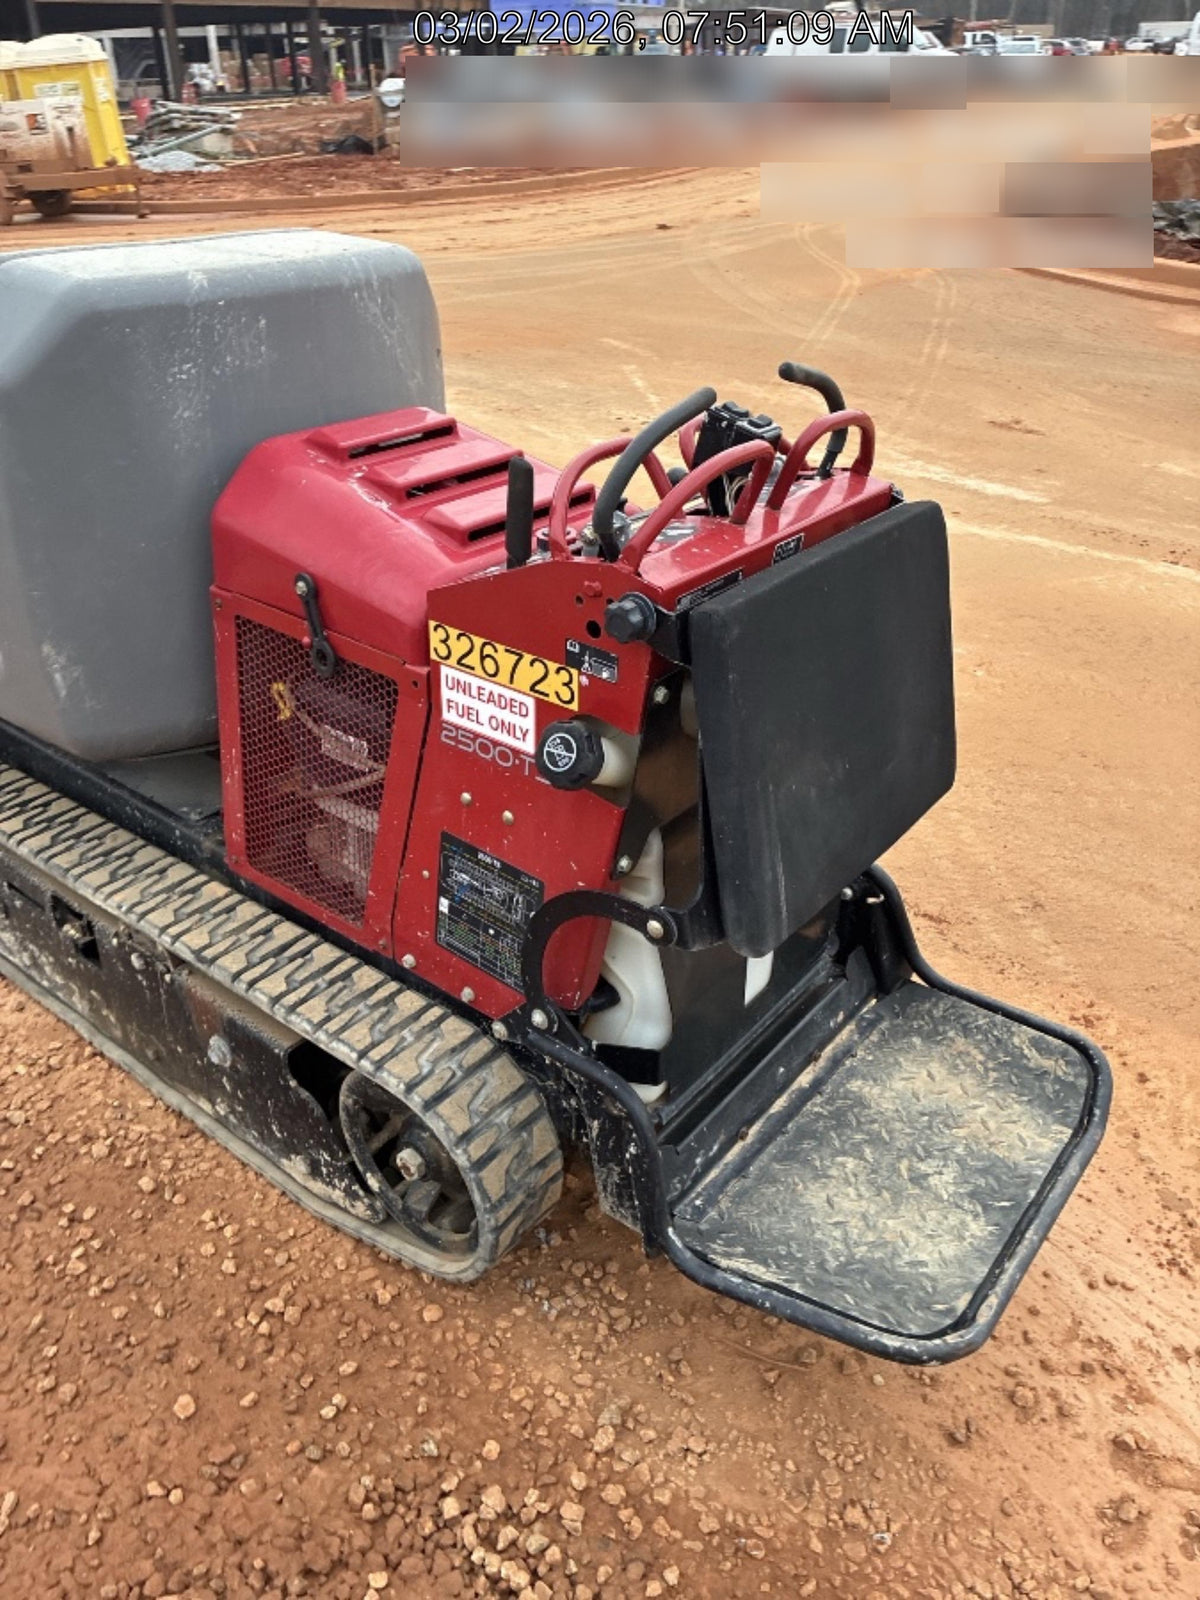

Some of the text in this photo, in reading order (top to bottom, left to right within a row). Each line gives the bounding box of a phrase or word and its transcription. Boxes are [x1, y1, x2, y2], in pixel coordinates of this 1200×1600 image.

[433, 624, 575, 705] 326723
[444, 674, 529, 718] UNLEADED
[446, 698, 530, 743] FUEL ONLY
